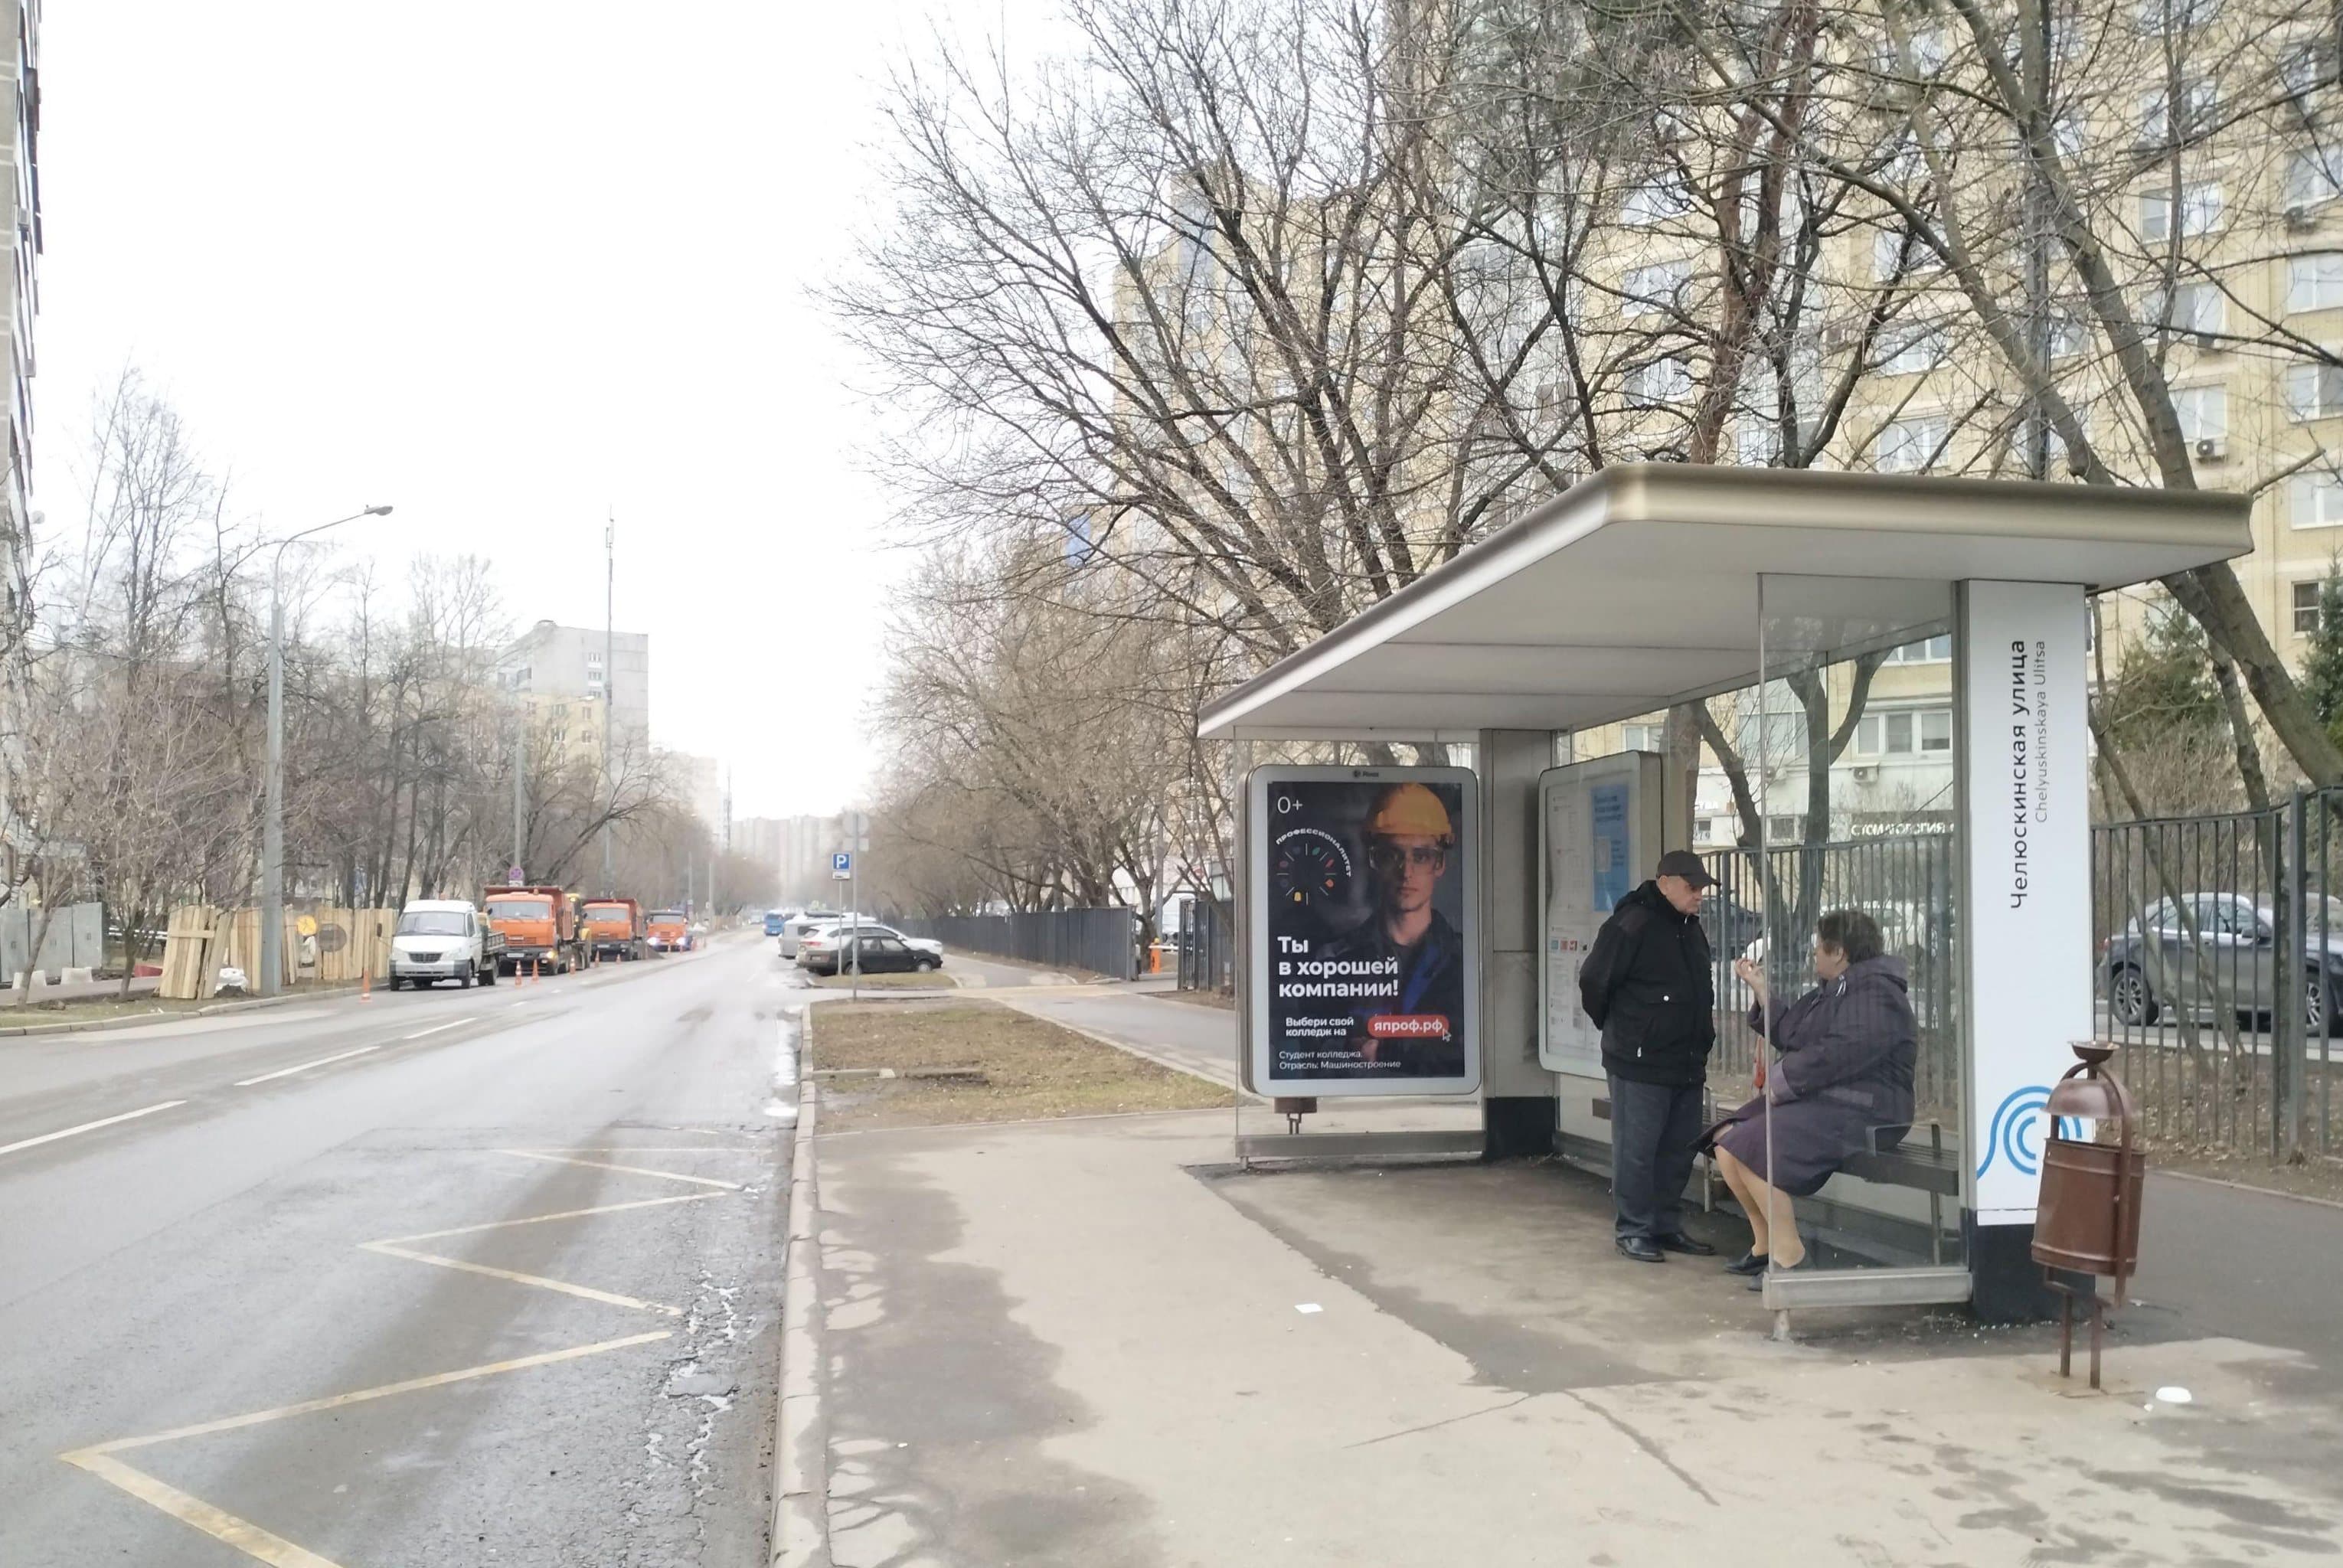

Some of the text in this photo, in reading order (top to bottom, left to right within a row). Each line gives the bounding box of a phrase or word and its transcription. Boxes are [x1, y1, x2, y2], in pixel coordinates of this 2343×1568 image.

[2033, 641, 2050, 823] Chelyuskinskaya Ulitsa
[2011, 640, 2030, 909] Челюскинская улица
[1277, 796, 1303, 814] 0+
[1276, 828, 1351, 877] ПРОФЕССИОНАЛИТЕТ
[836, 854, 847, 869] P
[1277, 936, 1309, 953] Ты
[1279, 956, 1398, 979] в хорошей
[1279, 979, 1399, 998] компании!
[1286, 1016, 1354, 1028] Выбери свой
[1374, 1018, 1443, 1032] япроф.рф
[1286, 1027, 1347, 1037] колледж на
[1279, 1050, 1315, 1060] Студент
[1279, 1060, 1402, 1070] Отрасль: Машиностроение
